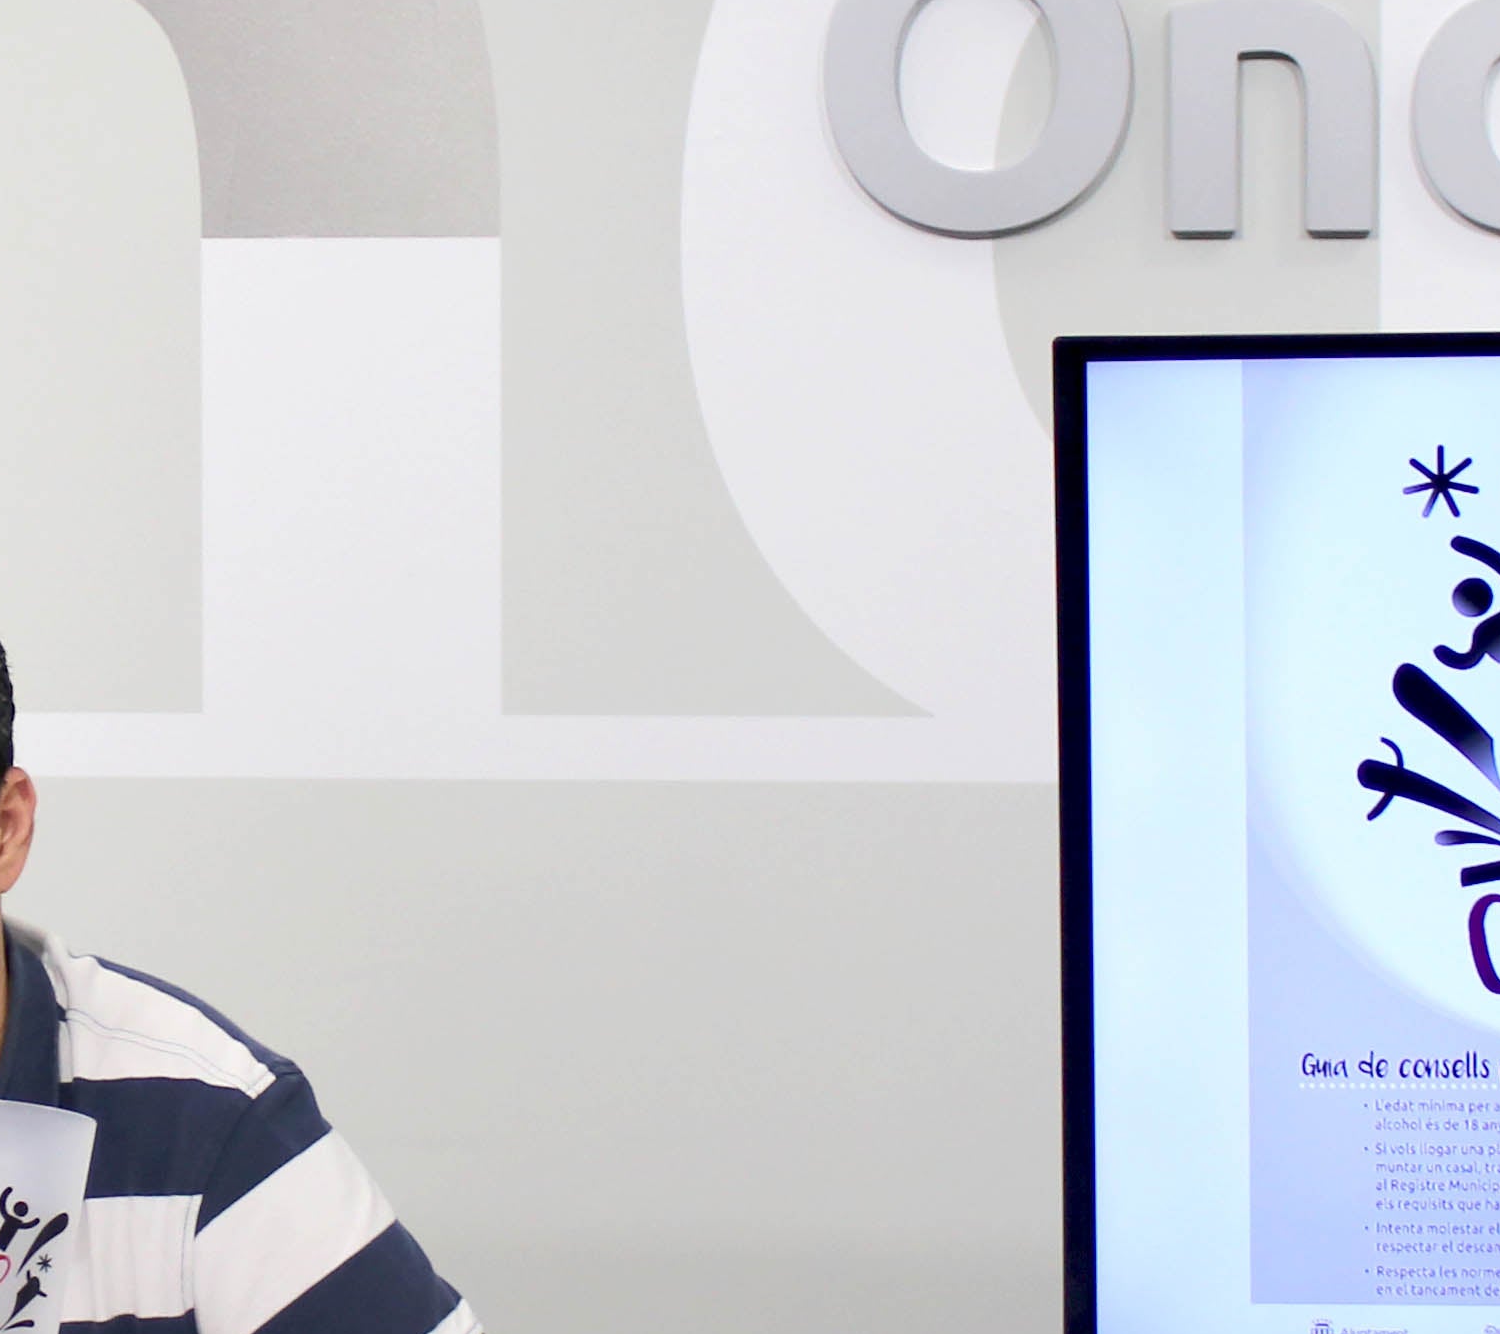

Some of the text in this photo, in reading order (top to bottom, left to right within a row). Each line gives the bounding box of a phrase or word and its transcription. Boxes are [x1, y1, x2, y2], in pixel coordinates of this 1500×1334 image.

[1302, 1052, 1347, 1079] Guia
[1359, 1051, 1388, 1079] de
[1400, 1052, 1490, 1079] consells
